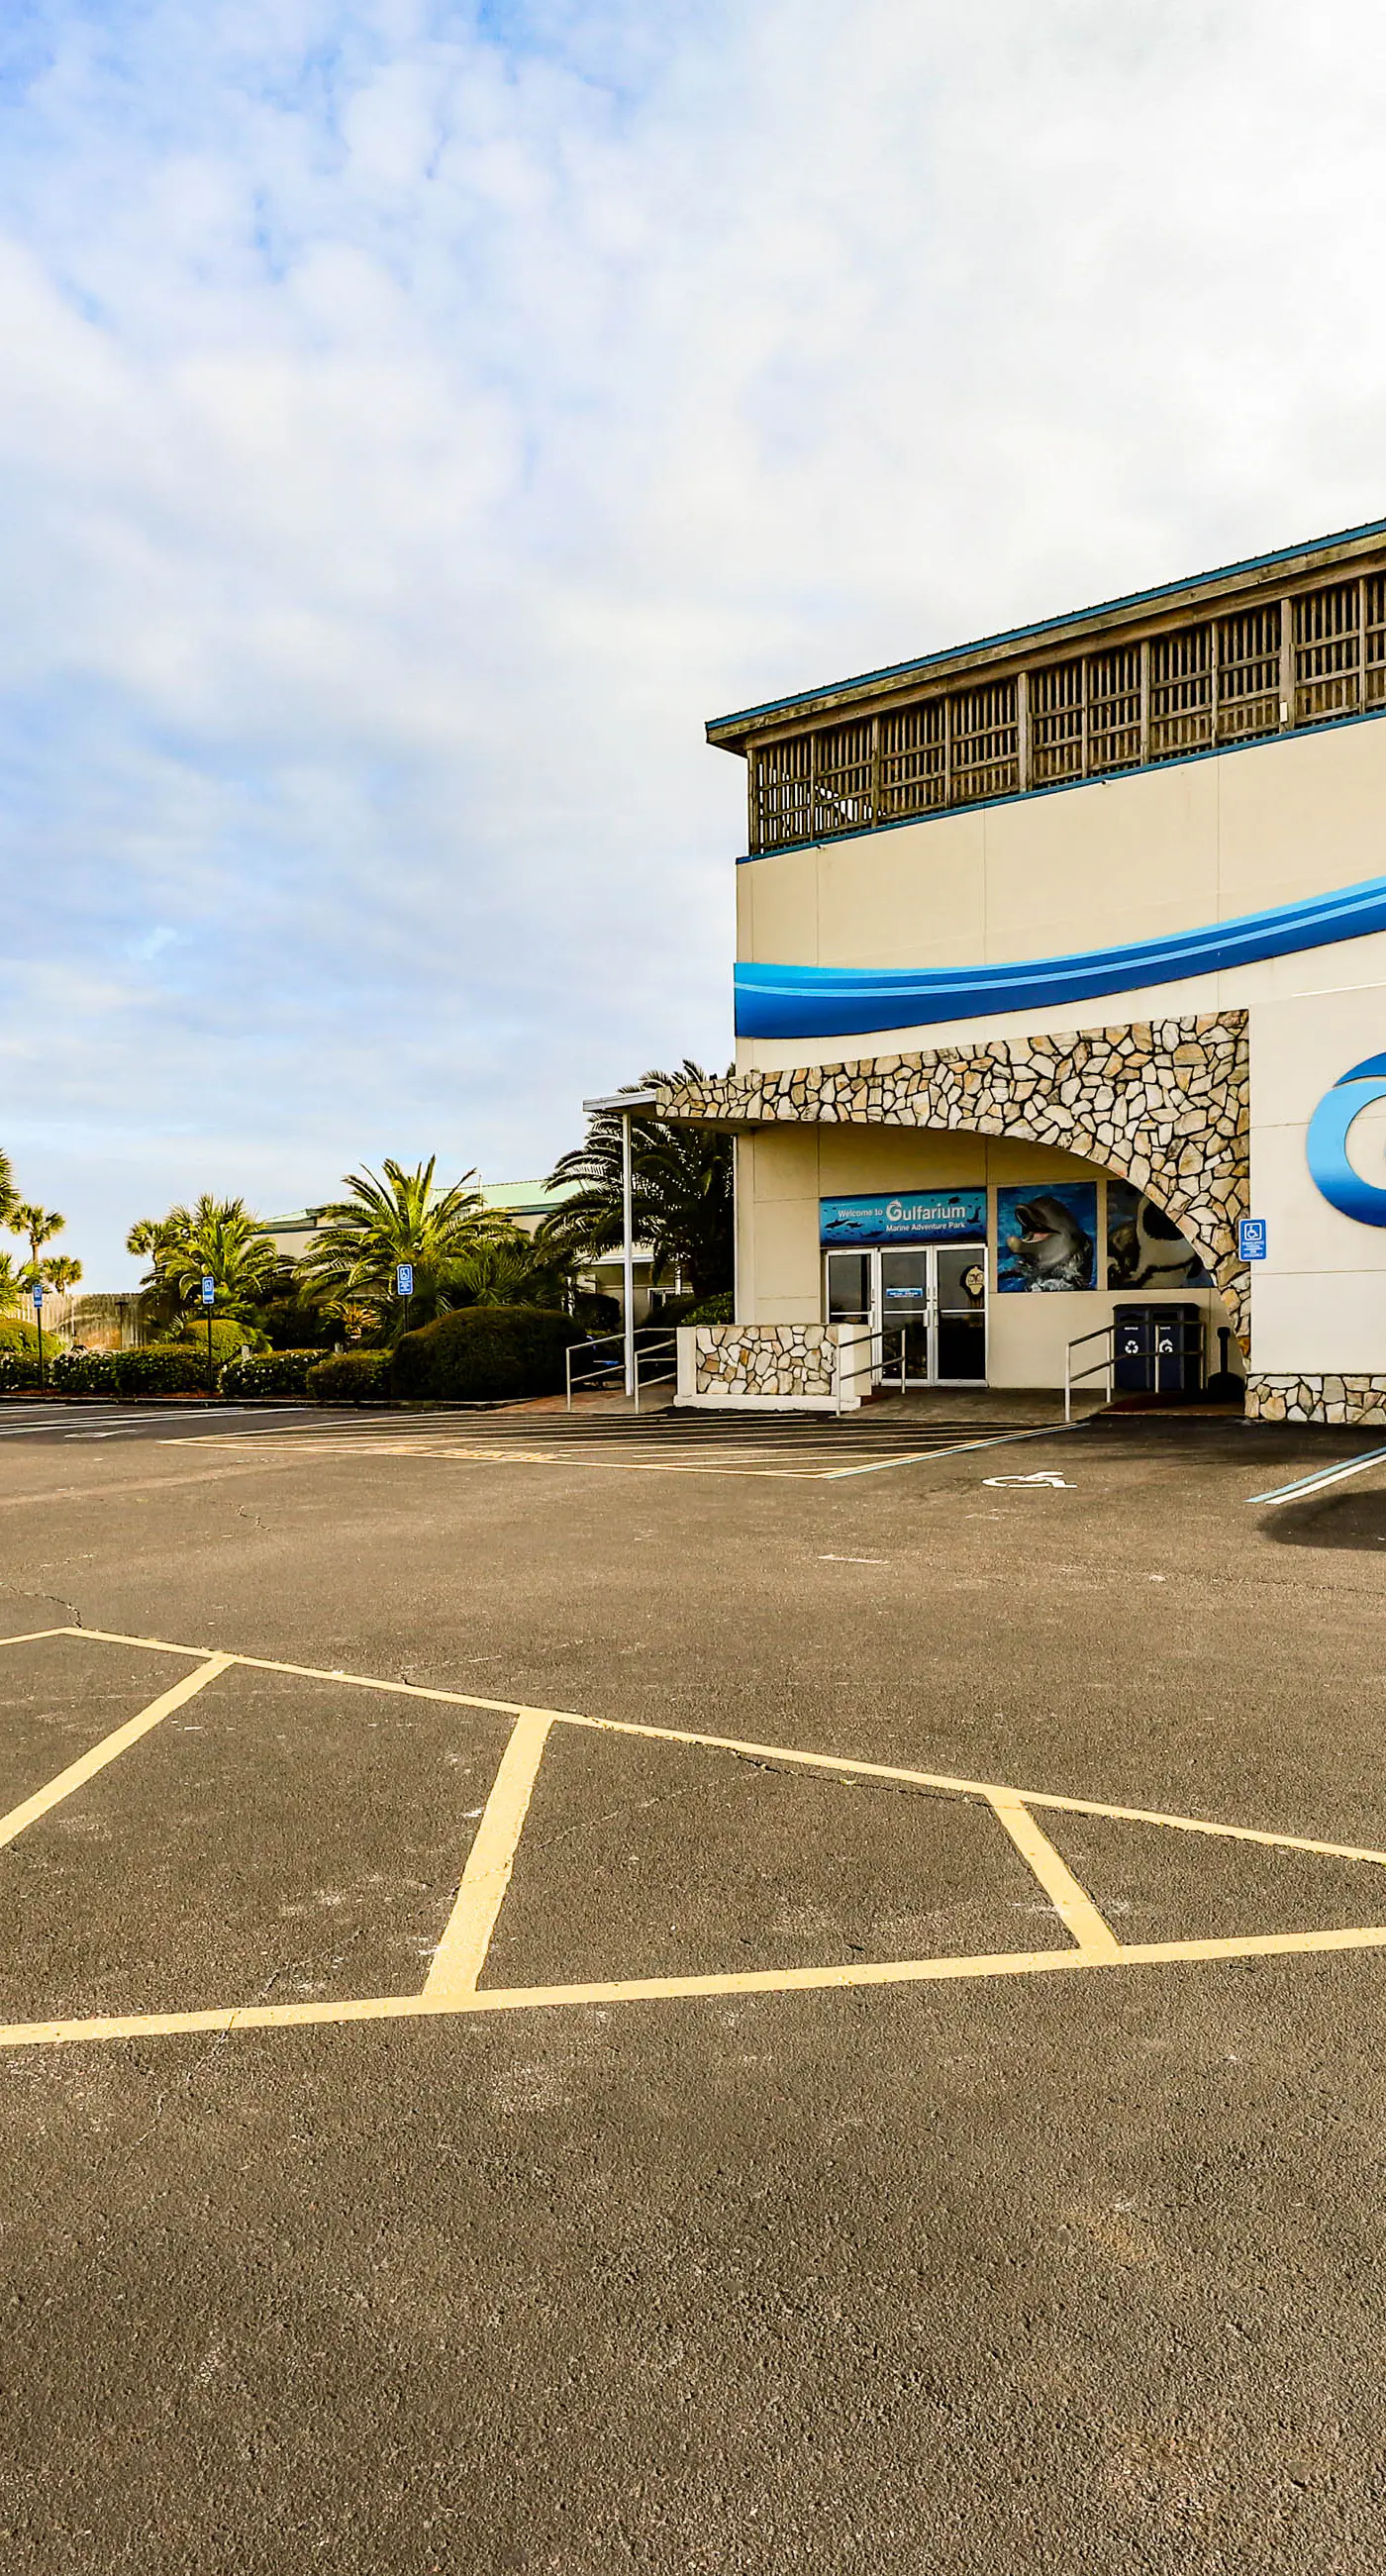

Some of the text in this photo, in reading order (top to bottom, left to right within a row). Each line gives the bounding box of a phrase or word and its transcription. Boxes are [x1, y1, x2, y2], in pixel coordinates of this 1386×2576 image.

[838, 1209, 872, 1218] Welcome
[886, 1200, 966, 1222] Gulfarium
[911, 1223, 946, 1232] Adventure
